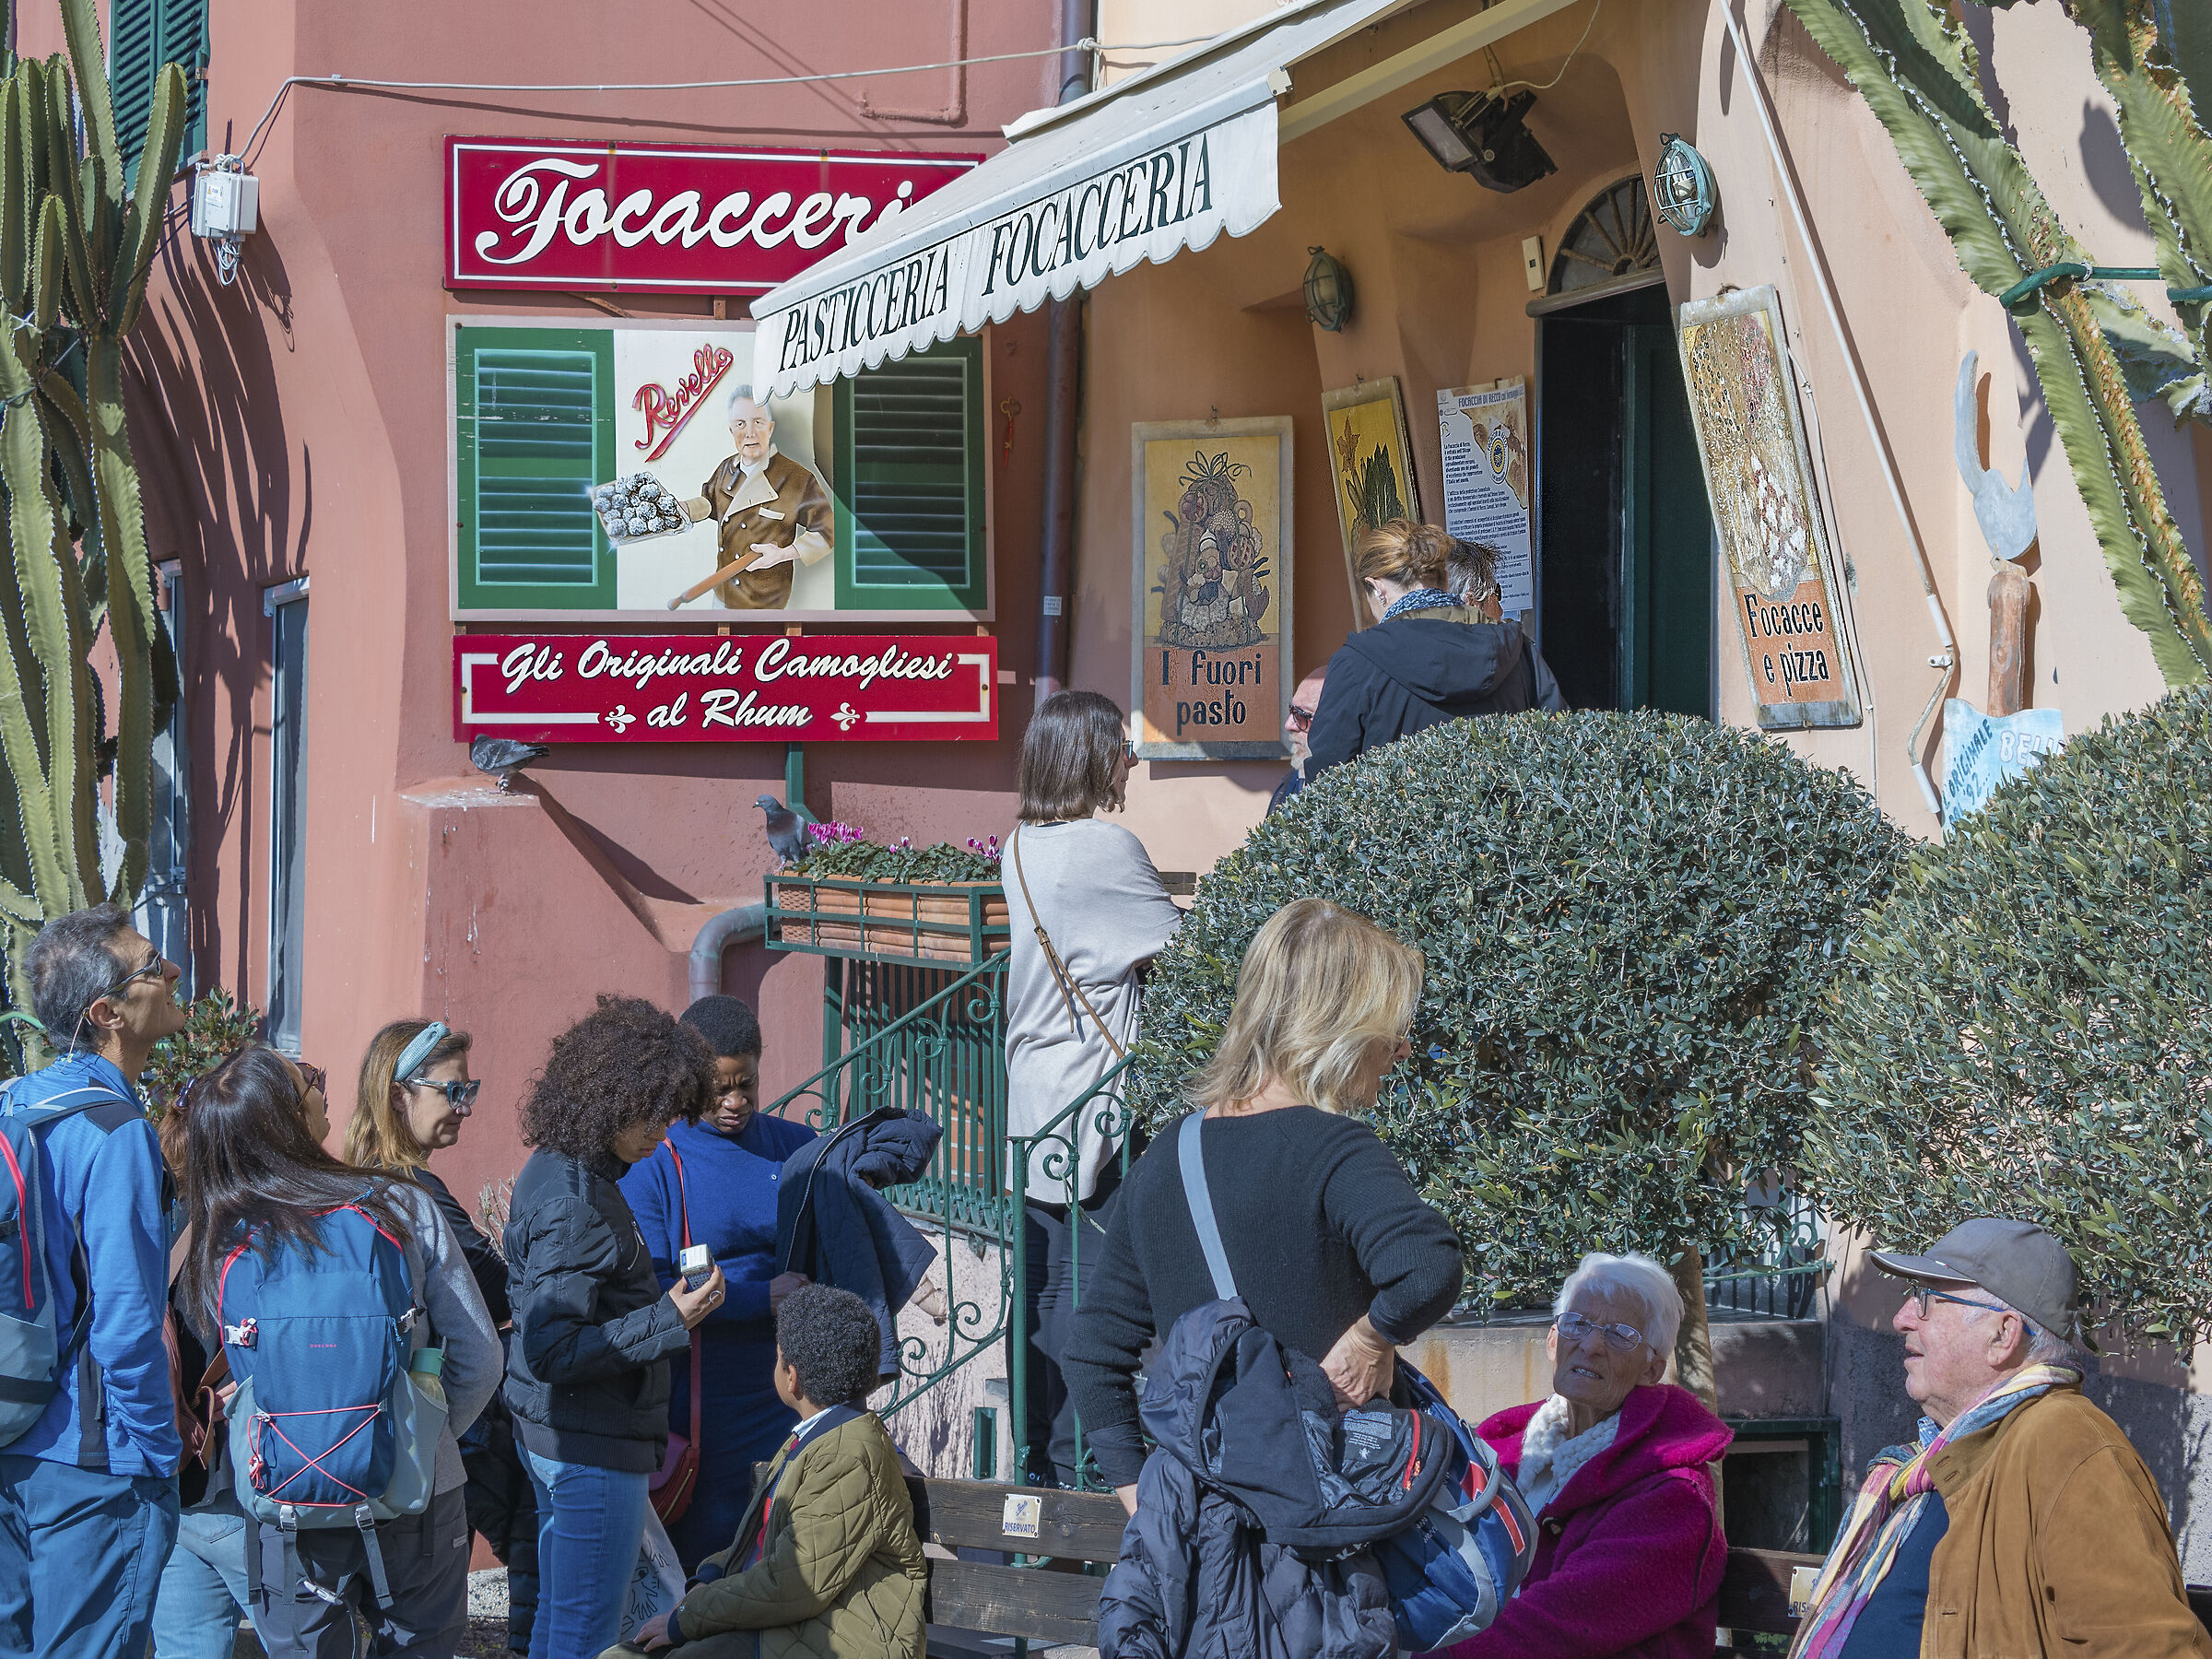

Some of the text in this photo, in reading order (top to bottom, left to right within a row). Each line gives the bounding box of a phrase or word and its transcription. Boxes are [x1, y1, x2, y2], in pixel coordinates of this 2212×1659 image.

[475, 158, 914, 265] Focacceri
[778, 132, 1215, 372] PASTICCERIA FOCACCERIA
[631, 343, 735, 452] Revello
[1743, 594, 1825, 638] Focacce
[500, 638, 954, 695] Gli Originali Camogliesi
[1162, 651, 1261, 685] I fuori
[1763, 642, 1830, 697] e pizza
[646, 688, 814, 728] al Rhum
[1177, 689, 1246, 735] pasto
[1942, 719, 1993, 810] L'ORIGINALE
[1005, 1522, 1036, 1534] RISERVATO
